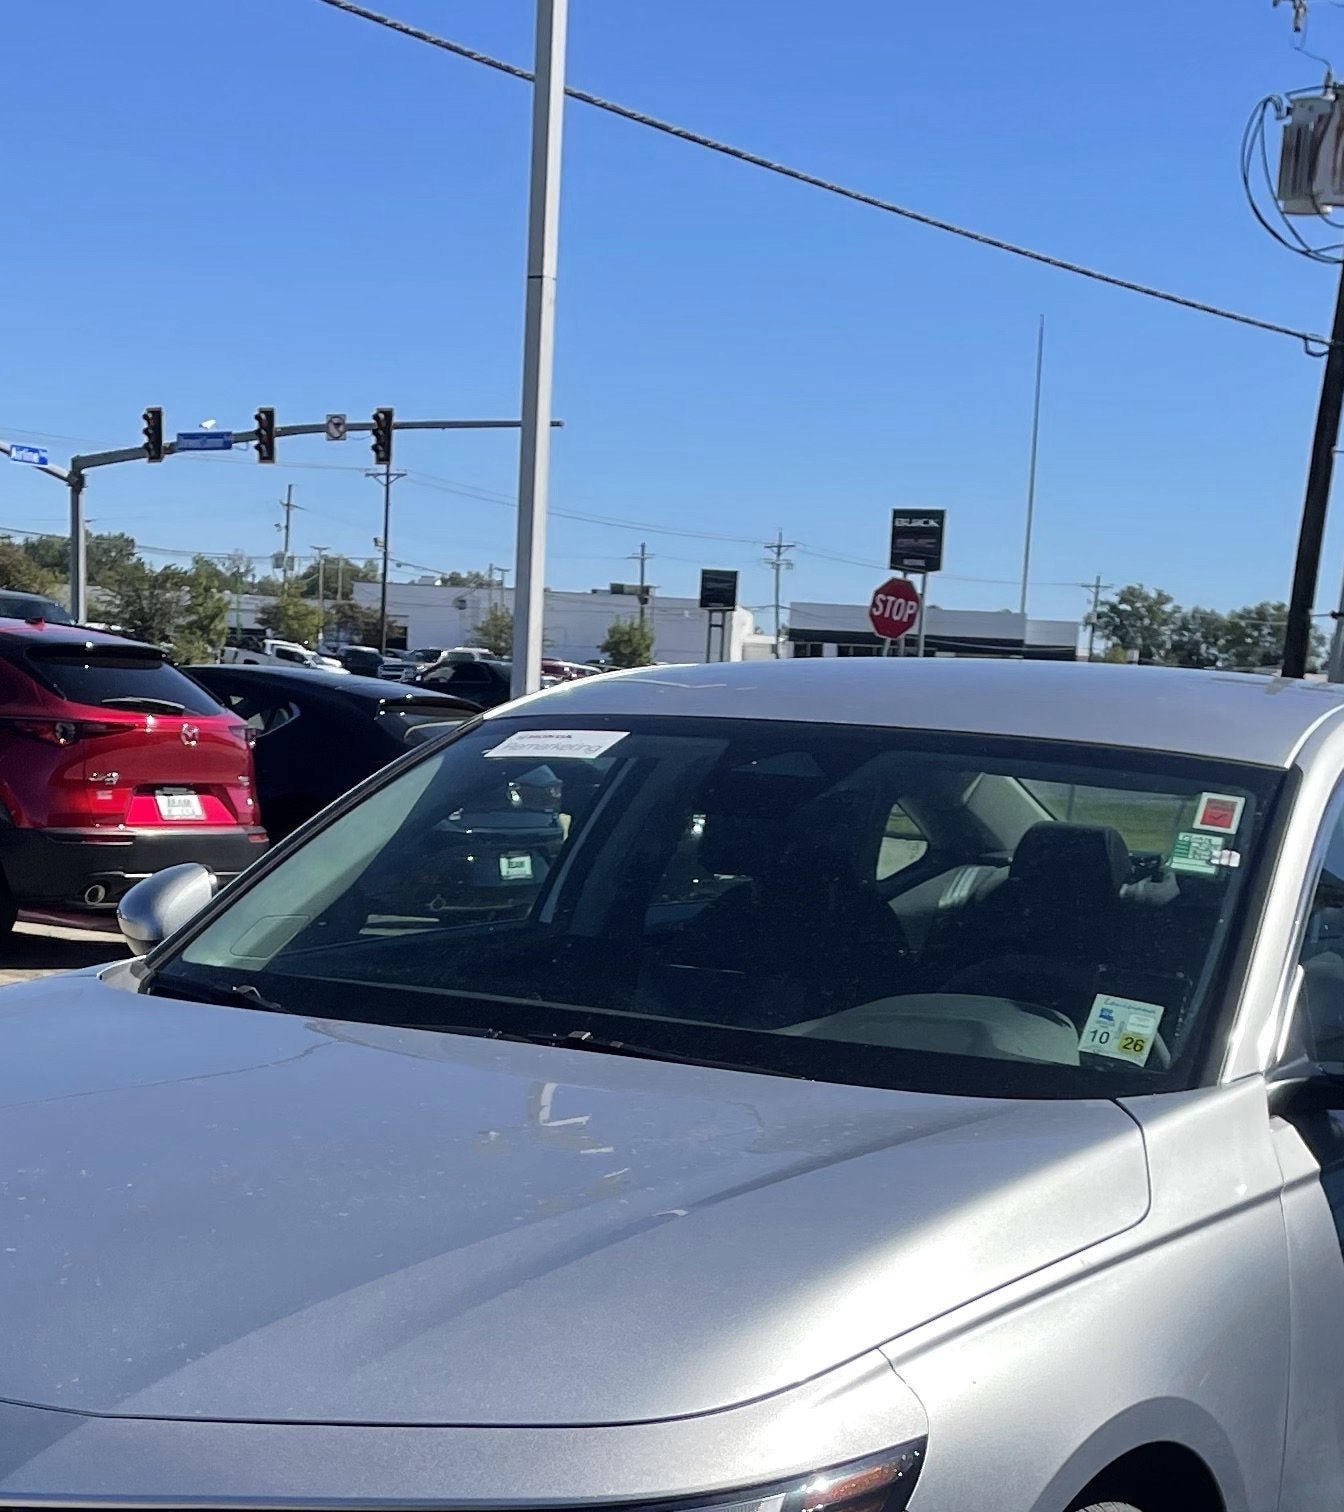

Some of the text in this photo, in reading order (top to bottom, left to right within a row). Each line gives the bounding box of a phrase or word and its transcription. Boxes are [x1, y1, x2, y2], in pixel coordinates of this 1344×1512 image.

[894, 518, 940, 527] BUICK
[871, 594, 918, 622] STOP
[1089, 1029, 1146, 1052] 10 26
